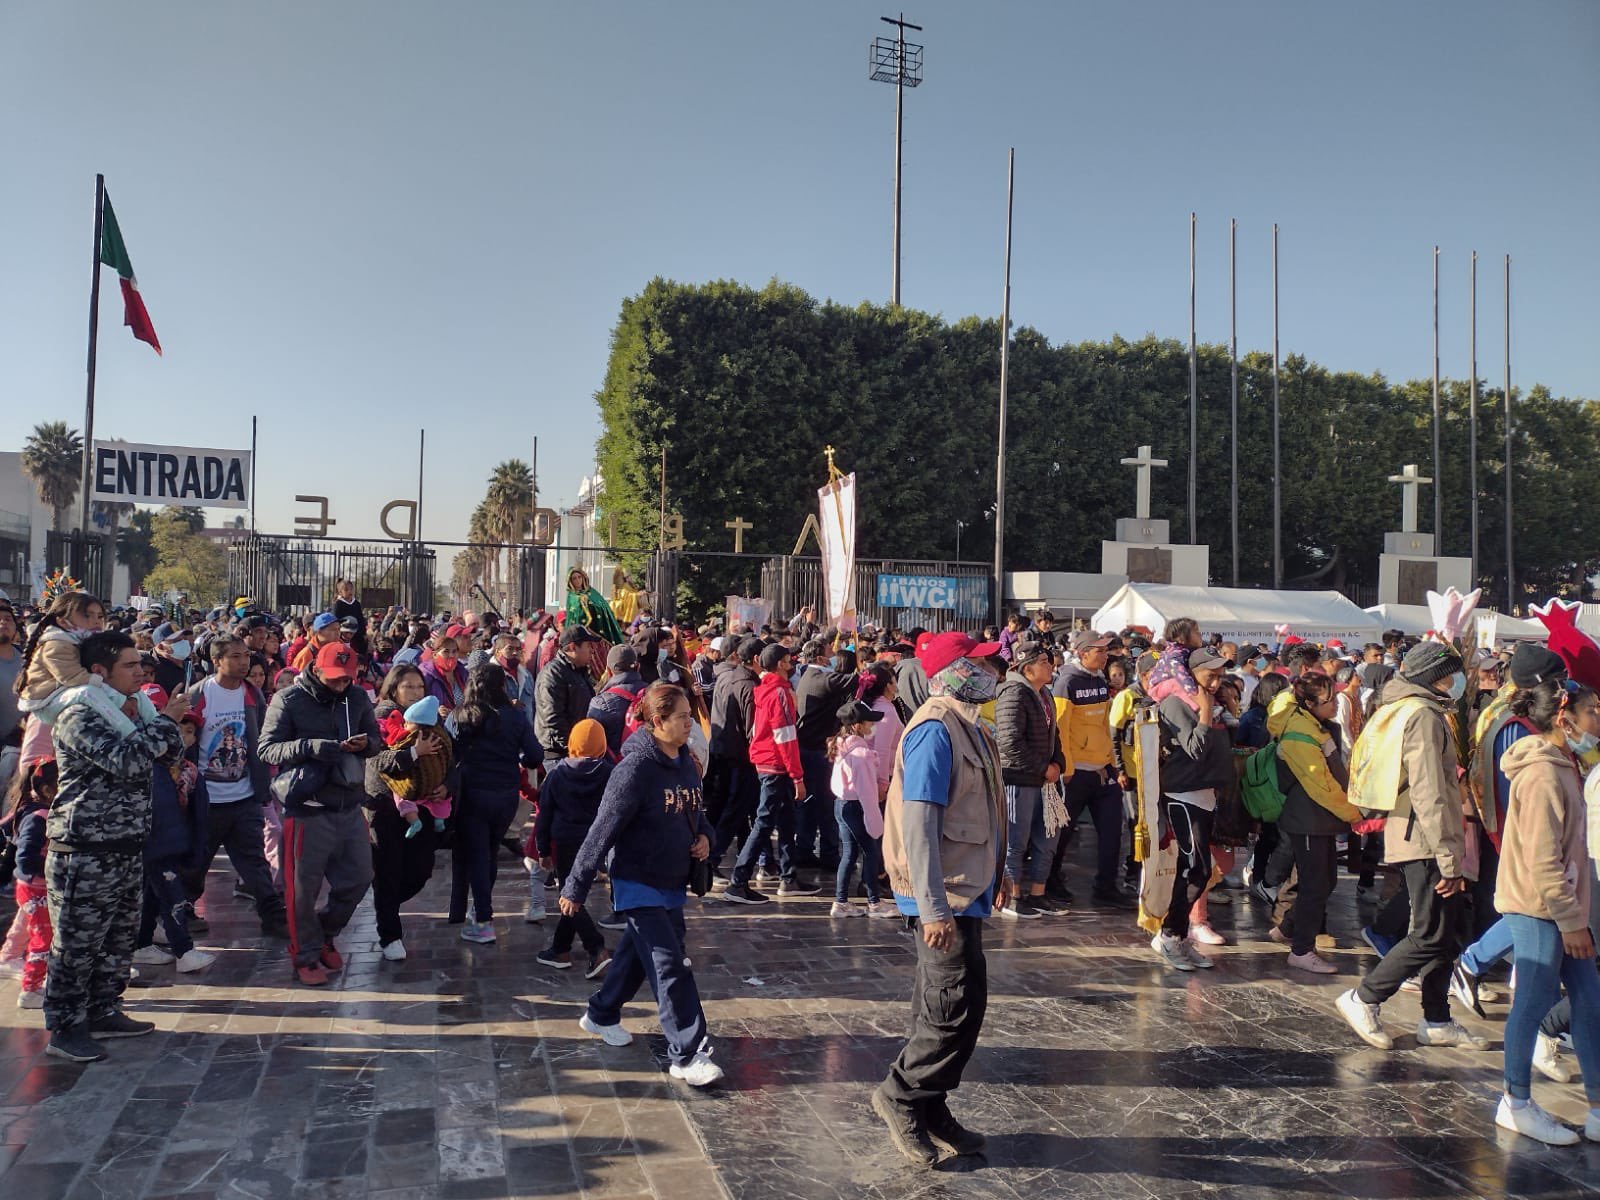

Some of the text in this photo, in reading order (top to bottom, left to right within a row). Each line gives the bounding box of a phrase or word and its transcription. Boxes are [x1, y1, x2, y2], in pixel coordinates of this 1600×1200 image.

[95, 447, 246, 501] ENTRADA
[899, 577, 947, 588] BAÑOS
[900, 586, 946, 609] WC
